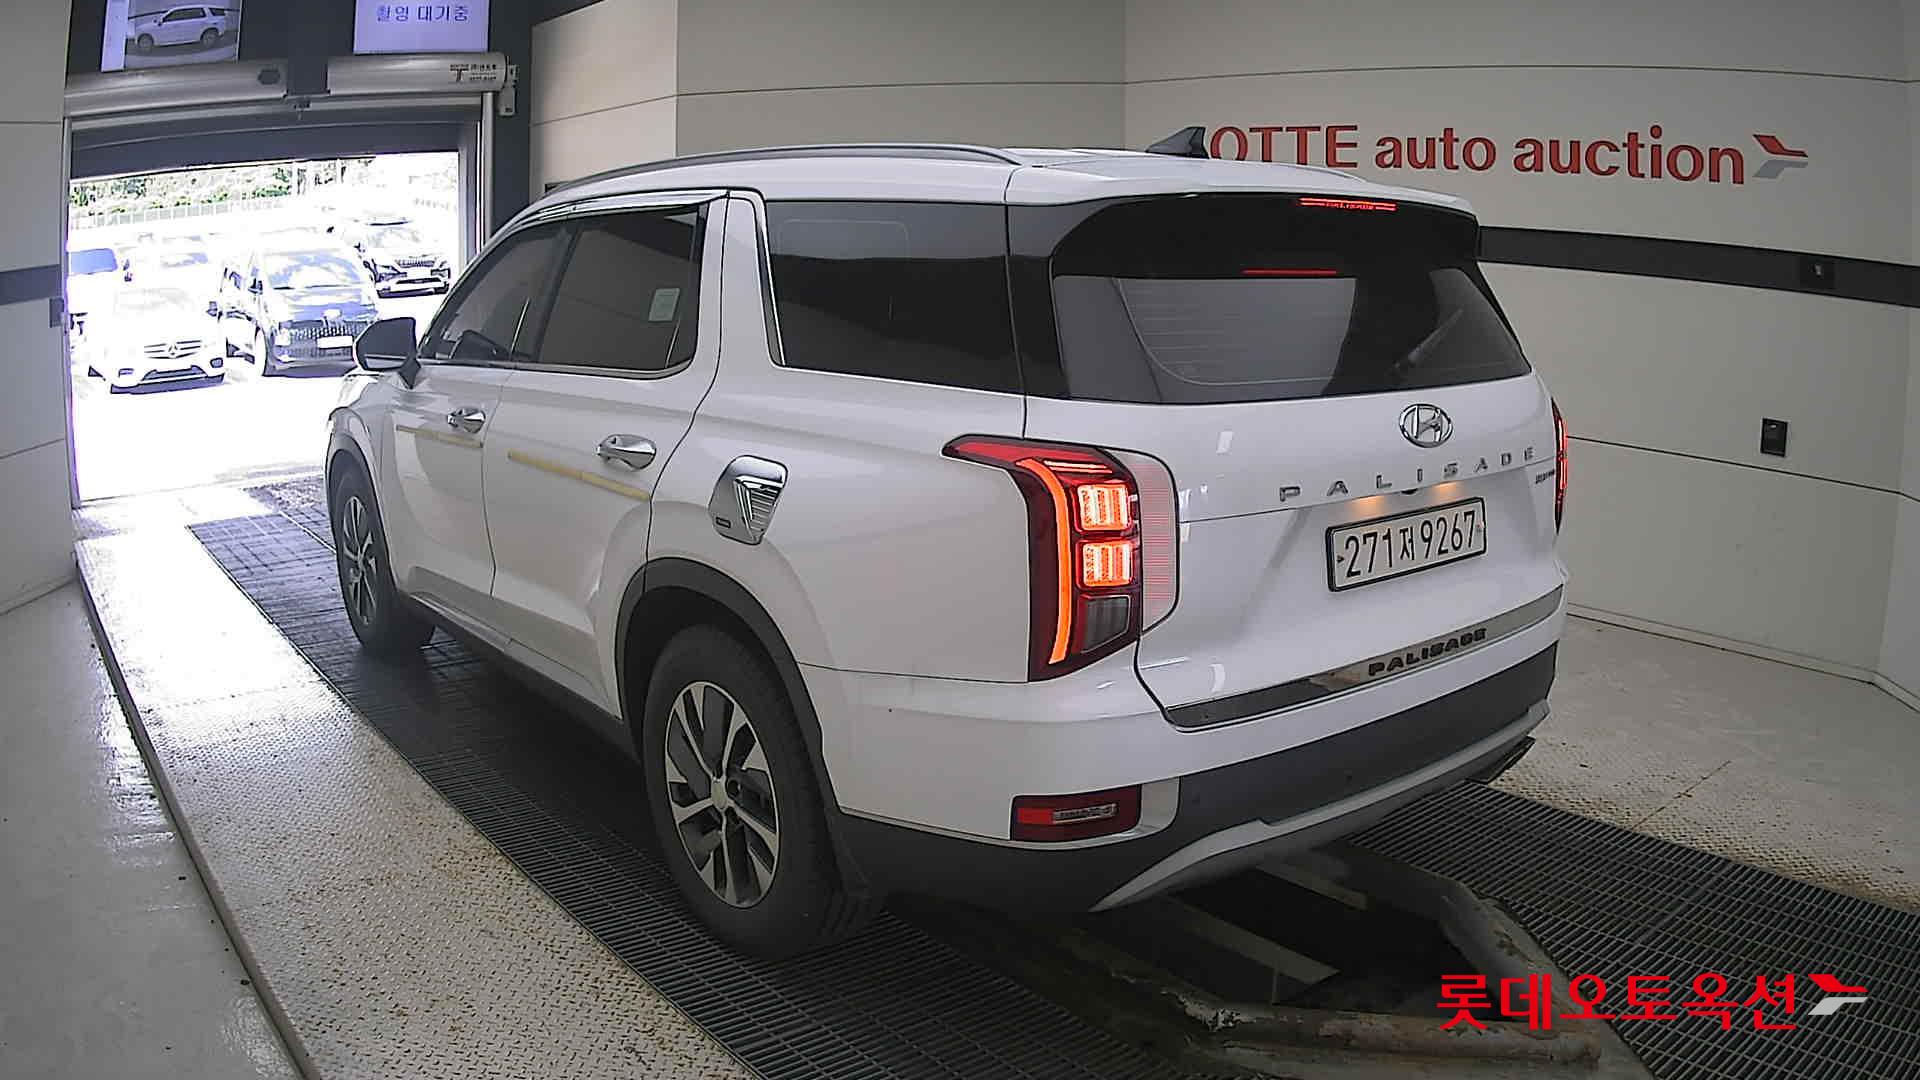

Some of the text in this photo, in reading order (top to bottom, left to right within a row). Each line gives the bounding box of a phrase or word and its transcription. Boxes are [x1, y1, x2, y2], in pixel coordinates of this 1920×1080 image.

[417, 5, 468, 22] 대기중
[1210, 124, 1745, 185] OTTE auto auction
[1279, 447, 1534, 502] PALISADE
[1368, 628, 1487, 676] PALISADE
